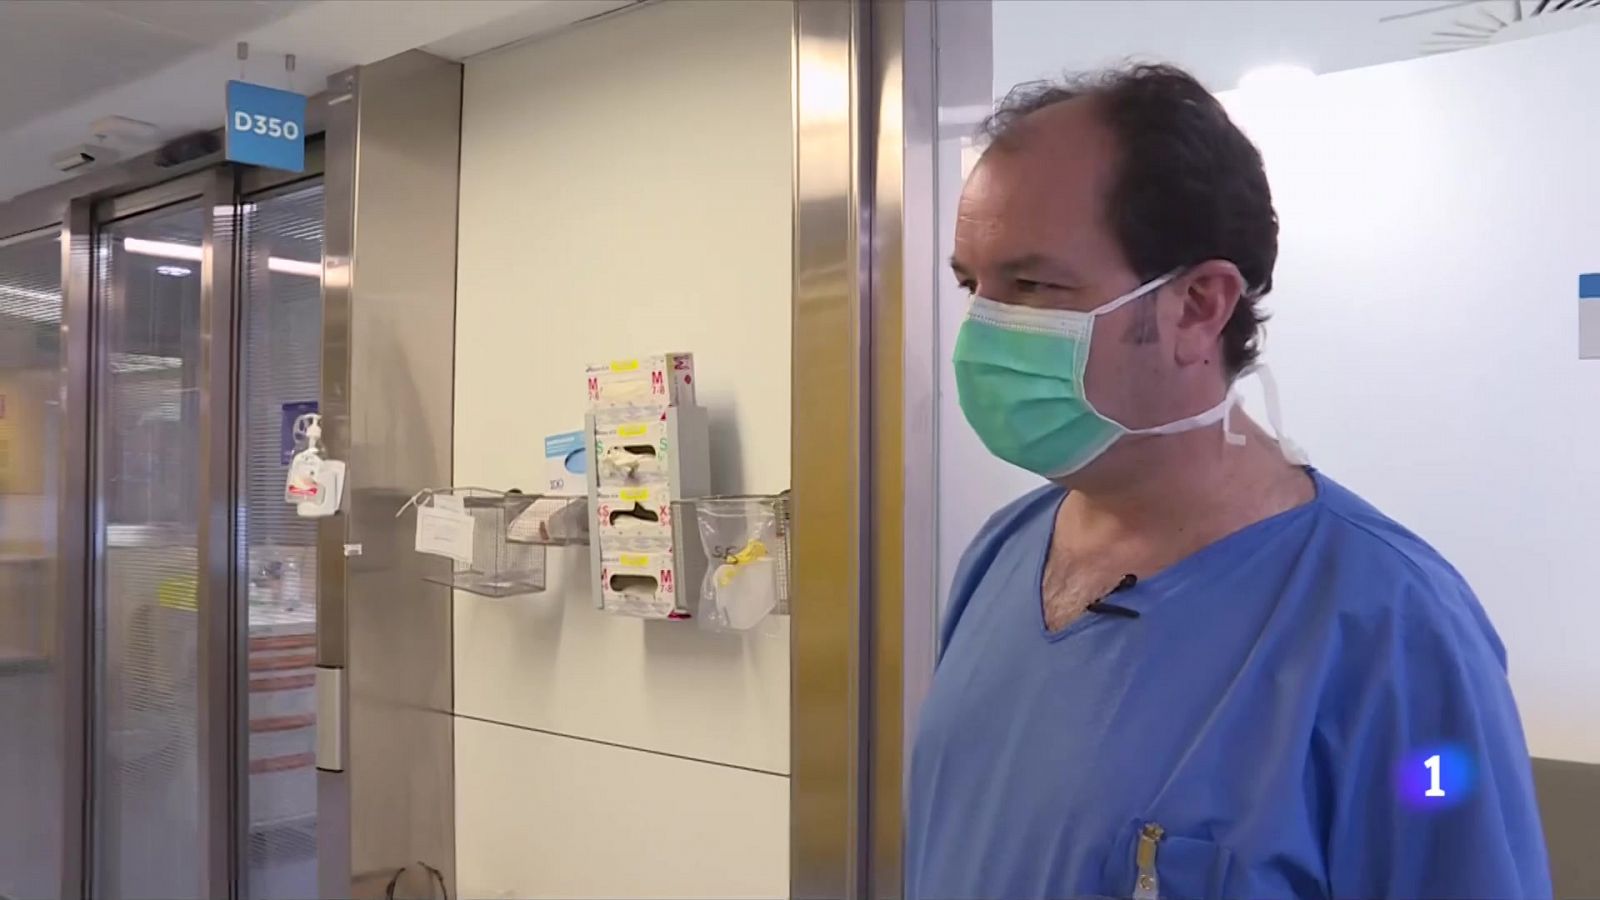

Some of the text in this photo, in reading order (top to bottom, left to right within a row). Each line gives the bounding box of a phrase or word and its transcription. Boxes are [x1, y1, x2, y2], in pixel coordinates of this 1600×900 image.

[234, 110, 299, 140] D350
[588, 377, 599, 390] M
[652, 371, 664, 385] M
[596, 440, 605, 455] S
[660, 438, 669, 451] S
[660, 569, 673, 583] M
